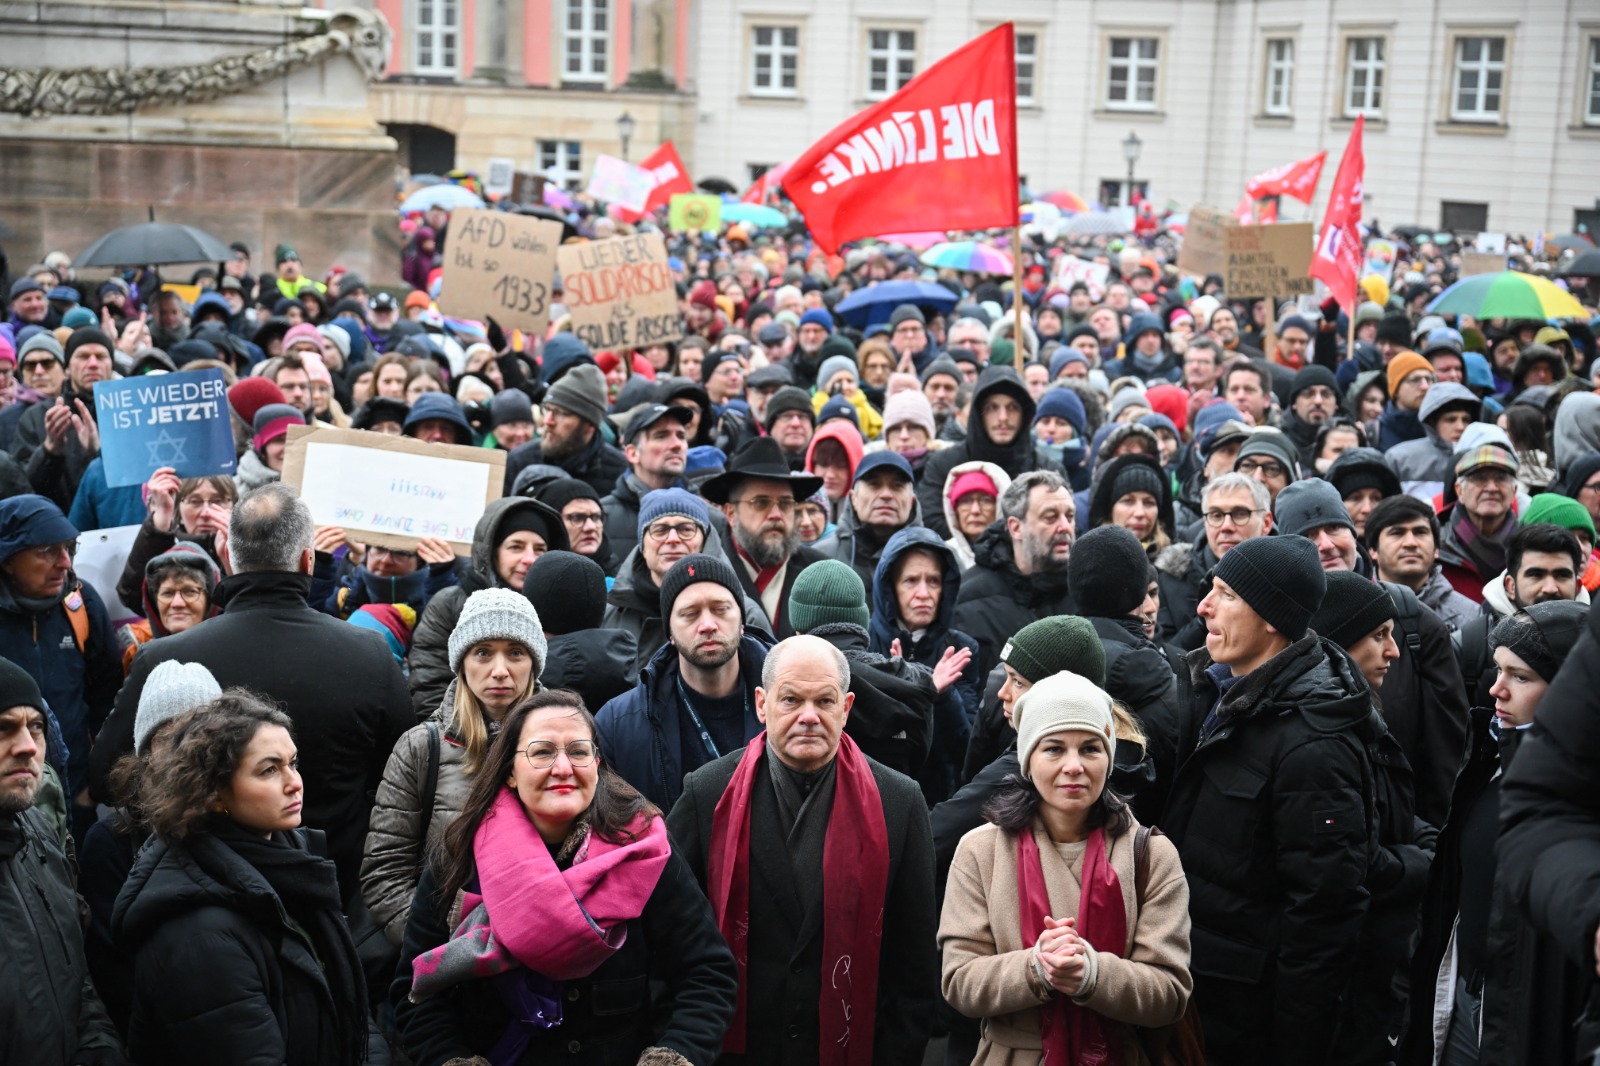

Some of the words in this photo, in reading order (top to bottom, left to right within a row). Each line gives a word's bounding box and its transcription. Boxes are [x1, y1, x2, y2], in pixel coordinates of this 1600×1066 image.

[458, 216, 506, 248] AfD
[483, 259, 500, 272] so
[578, 236, 654, 270] LIEBER
[493, 274, 547, 316] 1933
[99, 389, 134, 411] NIE
[137, 379, 225, 405] WIEDER
[112, 408, 143, 430] IST
[147, 400, 220, 426] JETZT!
